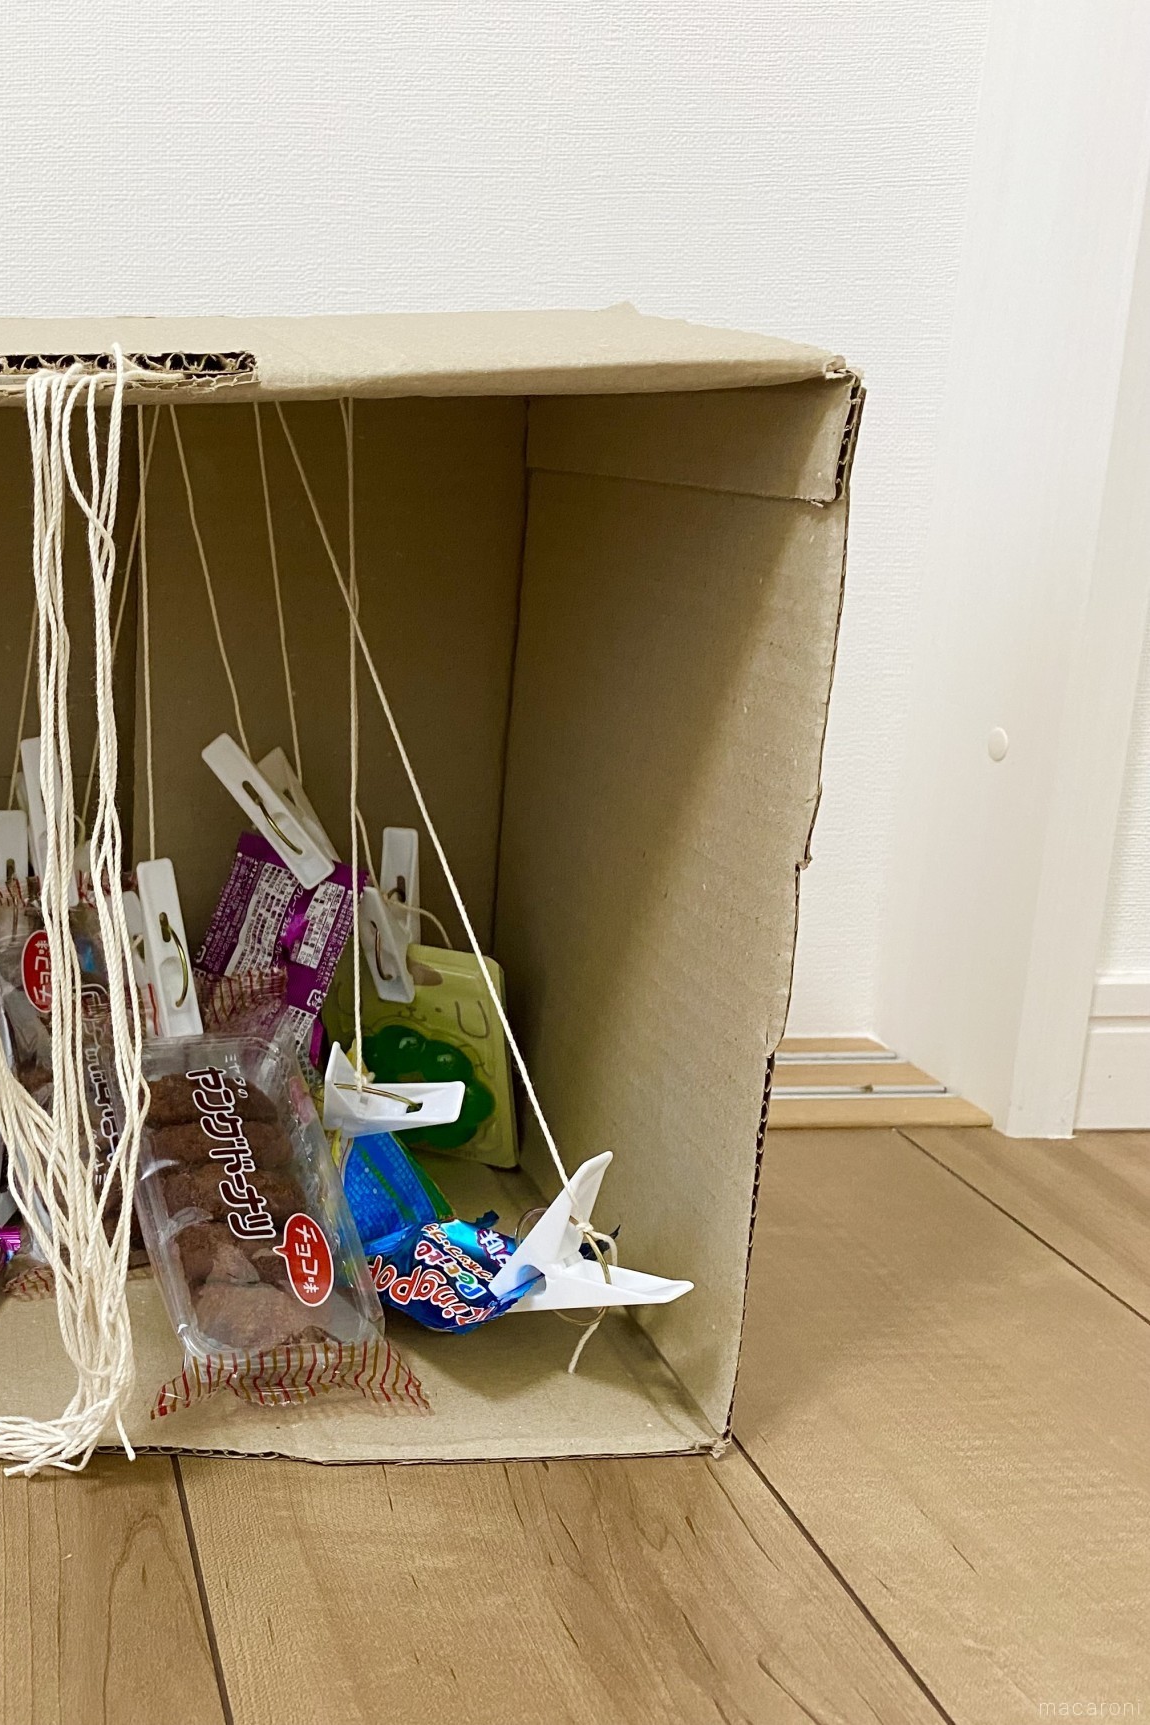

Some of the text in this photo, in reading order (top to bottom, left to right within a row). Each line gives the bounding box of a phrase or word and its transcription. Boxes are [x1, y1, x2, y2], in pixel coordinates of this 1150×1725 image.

[185, 1065, 278, 1240] ヤングドーナツ
[292, 1223, 321, 1295] チョコ味
